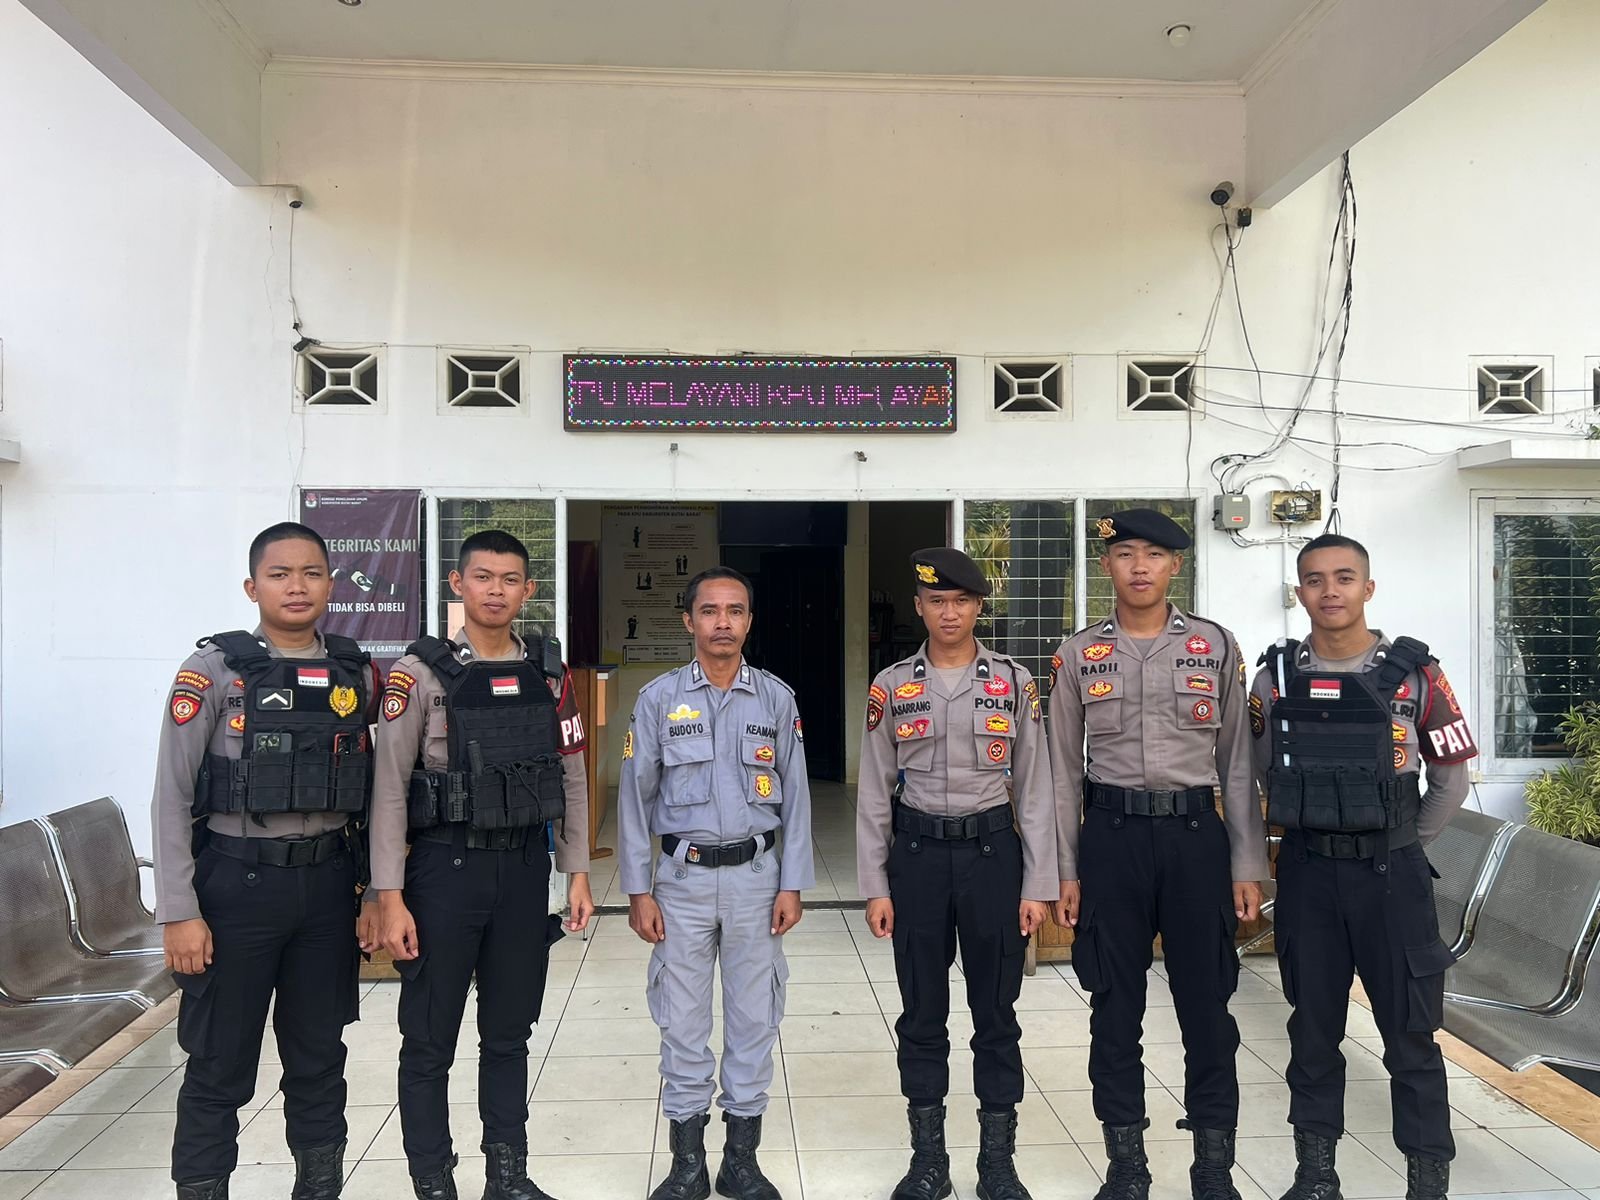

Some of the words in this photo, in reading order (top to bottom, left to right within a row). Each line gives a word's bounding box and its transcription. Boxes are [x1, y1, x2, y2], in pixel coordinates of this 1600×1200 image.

[324, 539, 381, 552] TEGRITAS
[385, 539, 416, 552] KAMI
[327, 602, 354, 613] TIDAK
[355, 602, 375, 612] BISA
[378, 602, 405, 612] DIBELI
[358, 645, 376, 653] OLAK
[376, 645, 408, 653] GRATIFIKA
[1176, 657, 1220, 670] POLRI
[974, 697, 1013, 713] POLRI
[1391, 702, 1415, 718] LRI
[669, 723, 704, 737] BUDOYO
